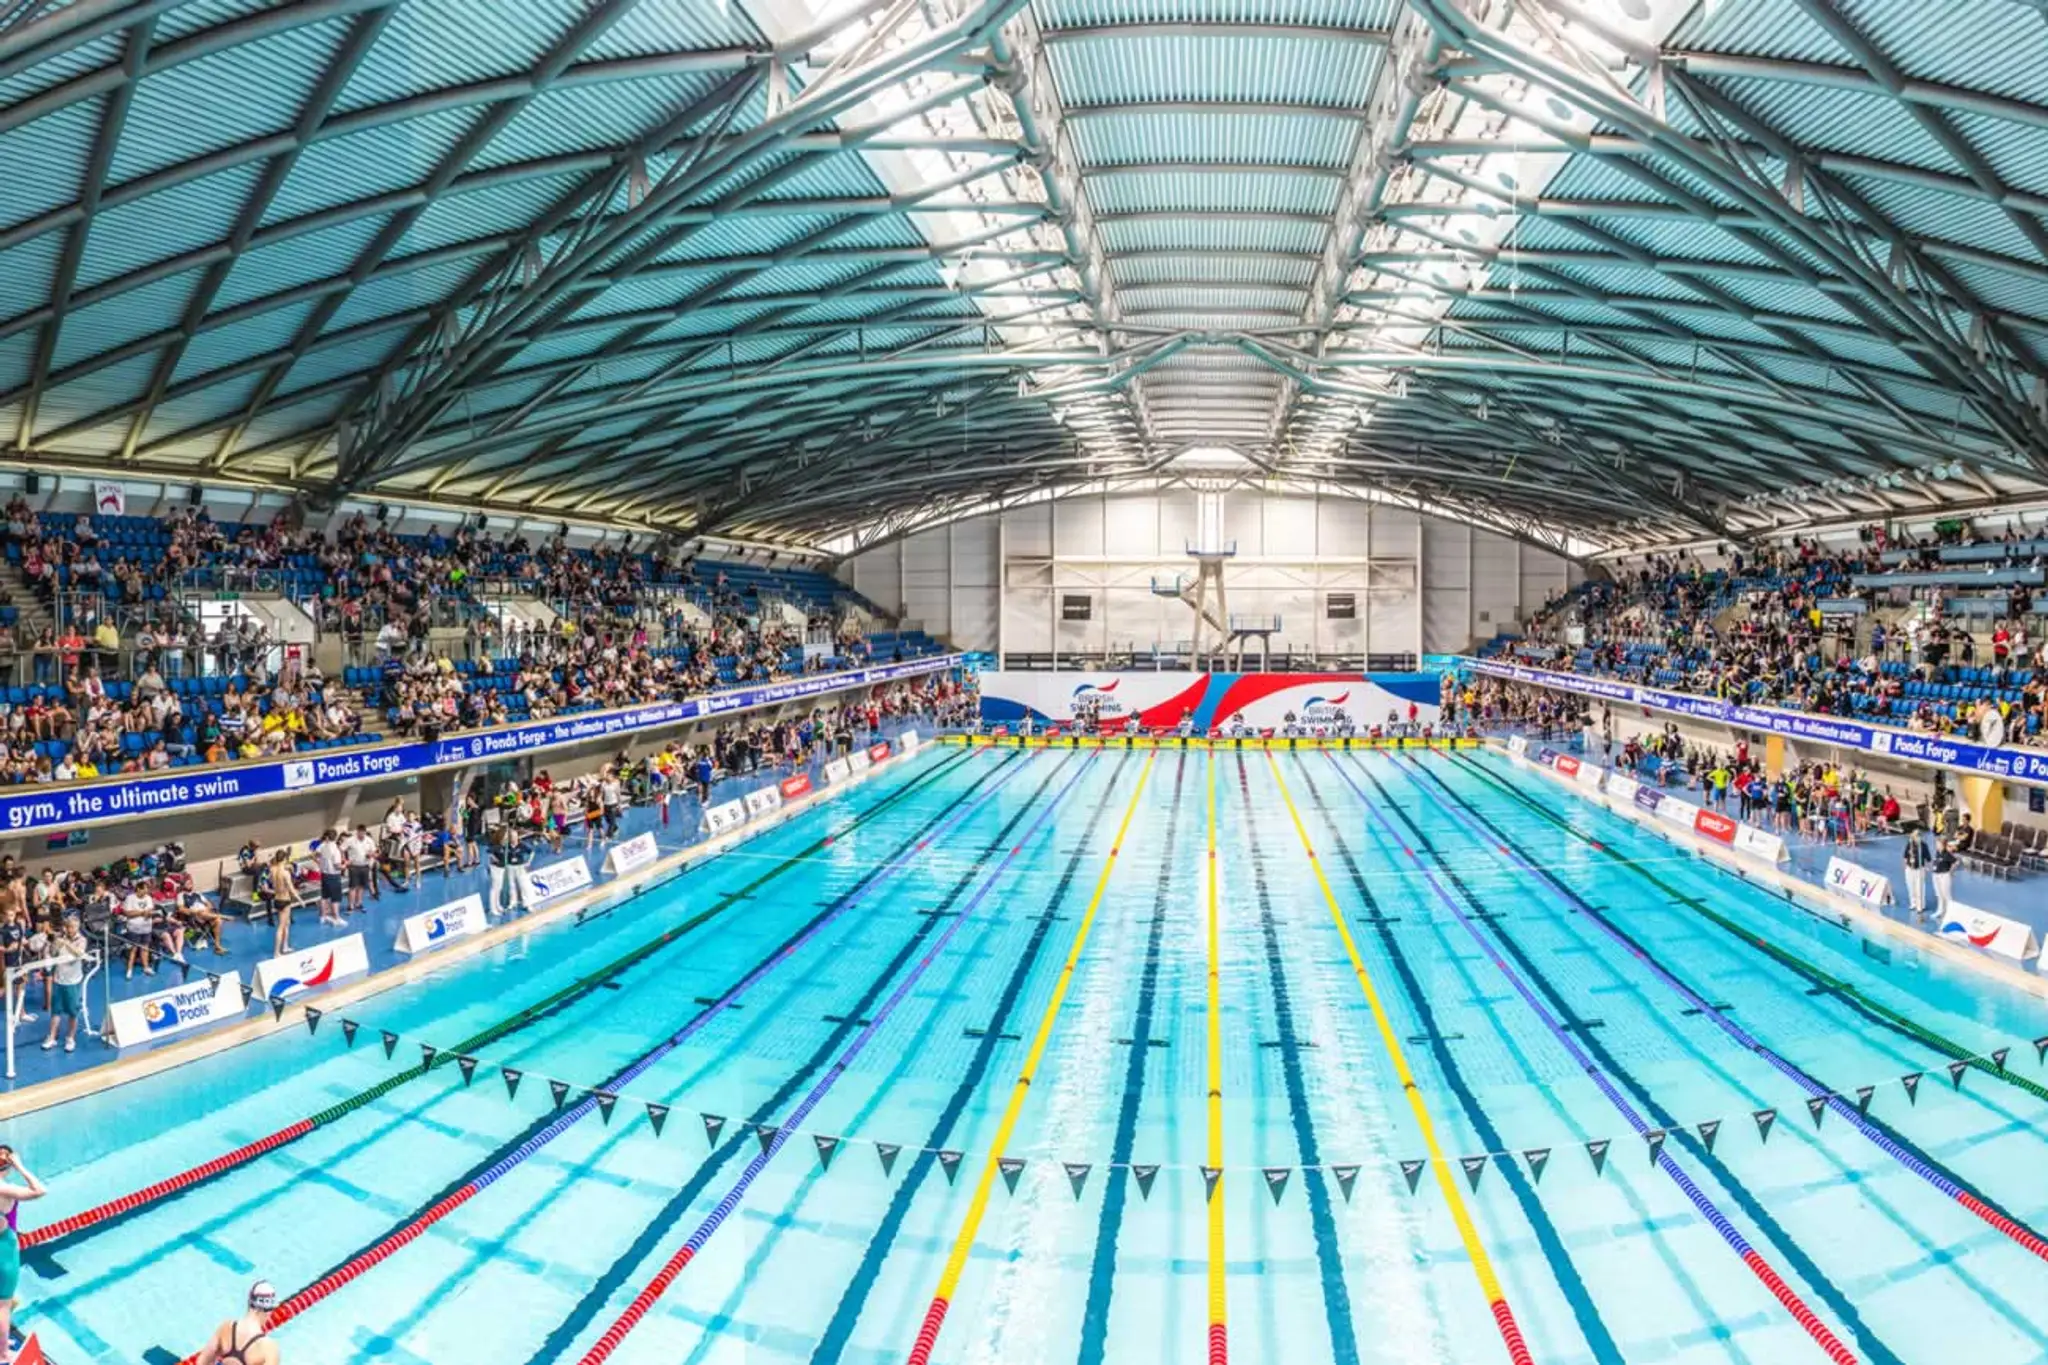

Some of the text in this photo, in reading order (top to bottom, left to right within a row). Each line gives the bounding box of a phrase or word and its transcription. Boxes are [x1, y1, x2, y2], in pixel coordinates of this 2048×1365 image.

[485, 732, 517, 751] Ponds
[519, 730, 547, 746] Forge
[555, 725, 569, 739] the
[1894, 737, 1924, 755] Ponds
[1926, 741, 1957, 762] Forge
[317, 753, 400, 779] Ponds Forge
[2030, 758, 2048, 776] Po
[8, 776, 240, 827] gym, the ultimate swim
[175, 985, 215, 1007] Myrtha
[179, 1004, 209, 1022] Pools
